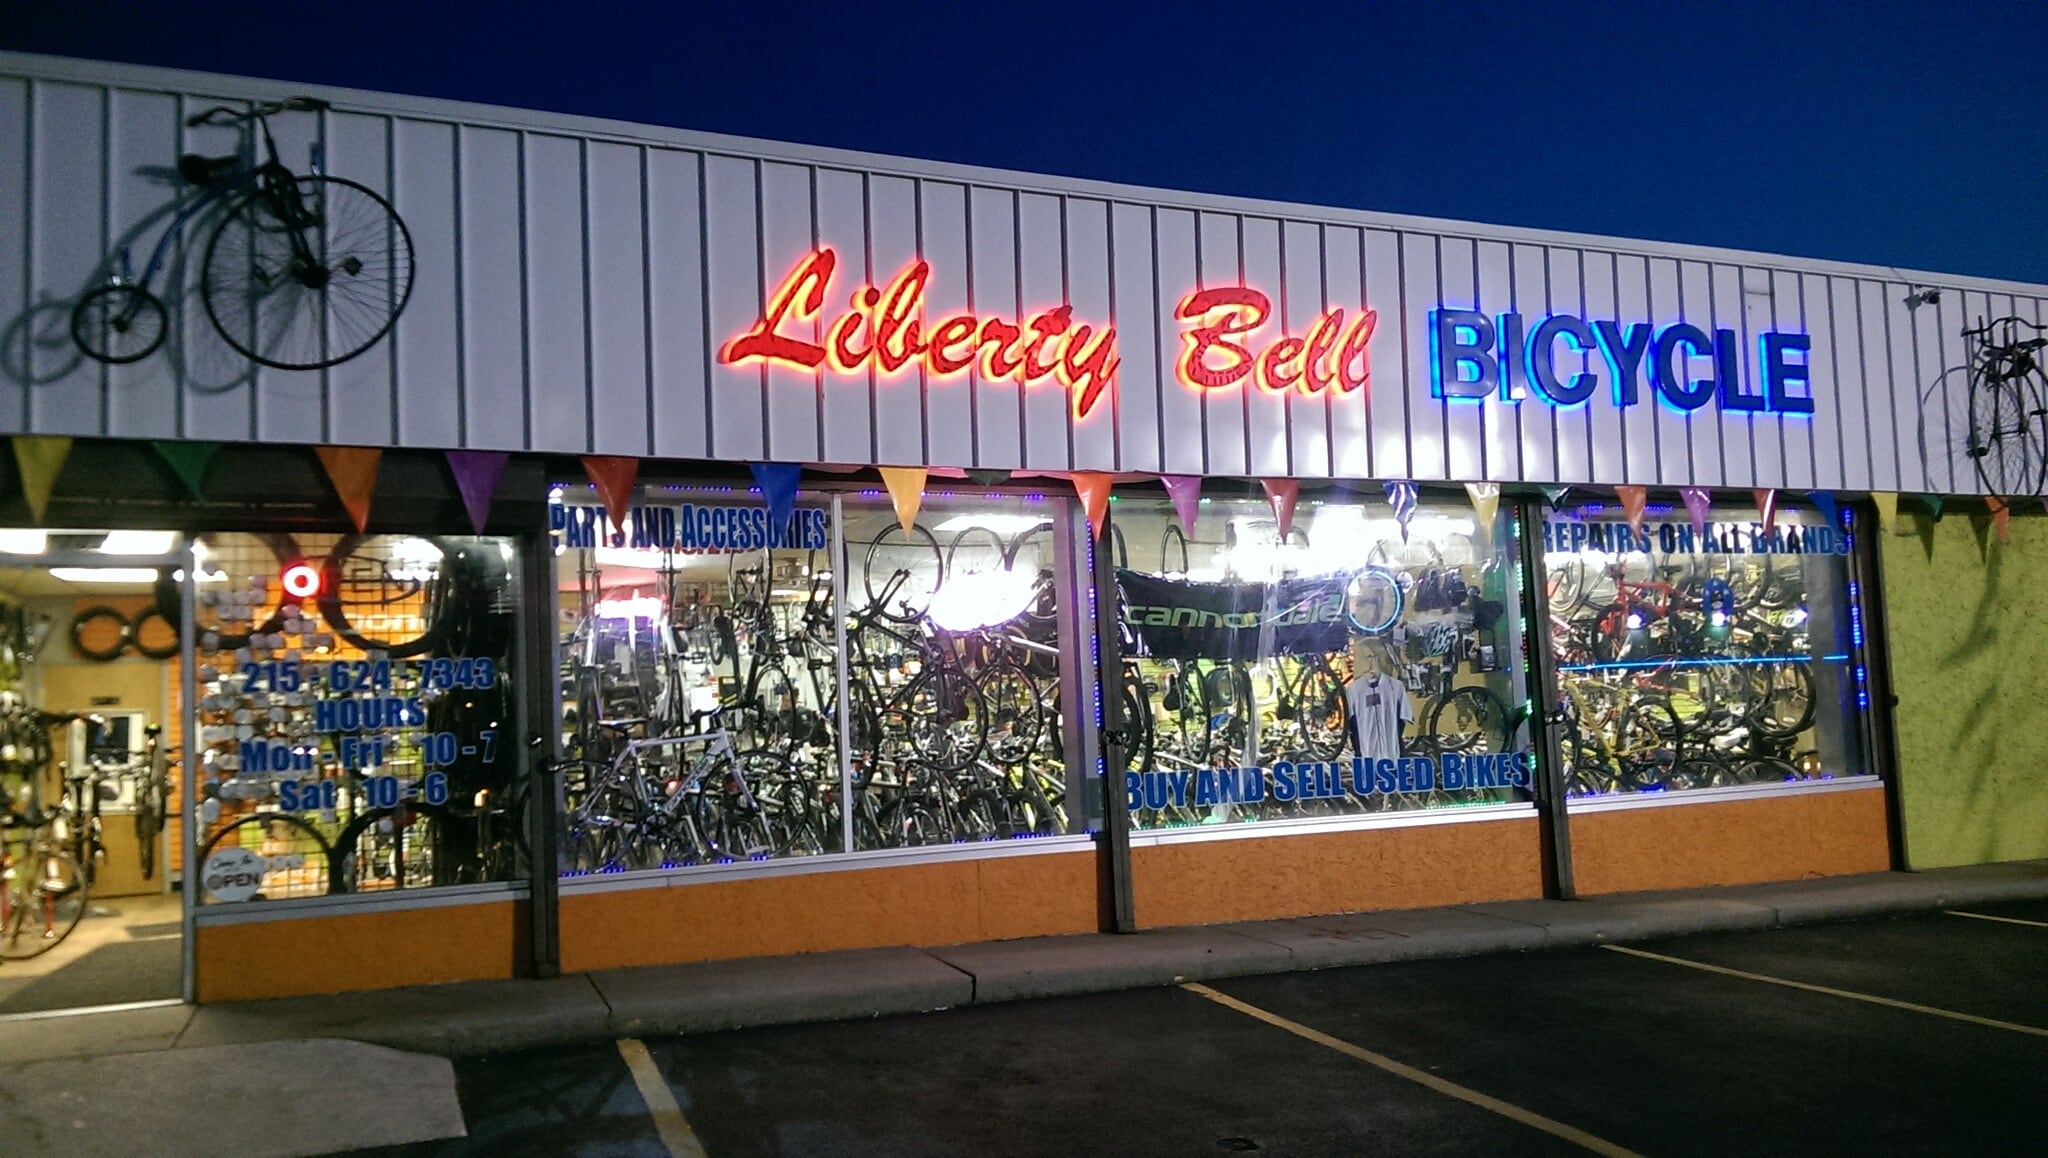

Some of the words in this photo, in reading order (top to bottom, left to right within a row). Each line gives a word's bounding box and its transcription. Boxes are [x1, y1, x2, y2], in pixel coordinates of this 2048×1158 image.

[718, 248, 1121, 418] Liberty
[1175, 287, 1378, 394] Bell
[1429, 307, 1815, 414] BICYCLE
[630, 506, 676, 549] AND
[1659, 522, 1696, 555] ON
[1702, 521, 1747, 554] ALL
[1124, 593, 1344, 629] cannodale
[315, 697, 426, 733] HOURS
[1126, 770, 1190, 811] BUY
[1194, 766, 1266, 807] AND
[1272, 760, 1347, 802] SELL
[1352, 756, 1435, 796] USED
[1441, 751, 1531, 791] BIKES
